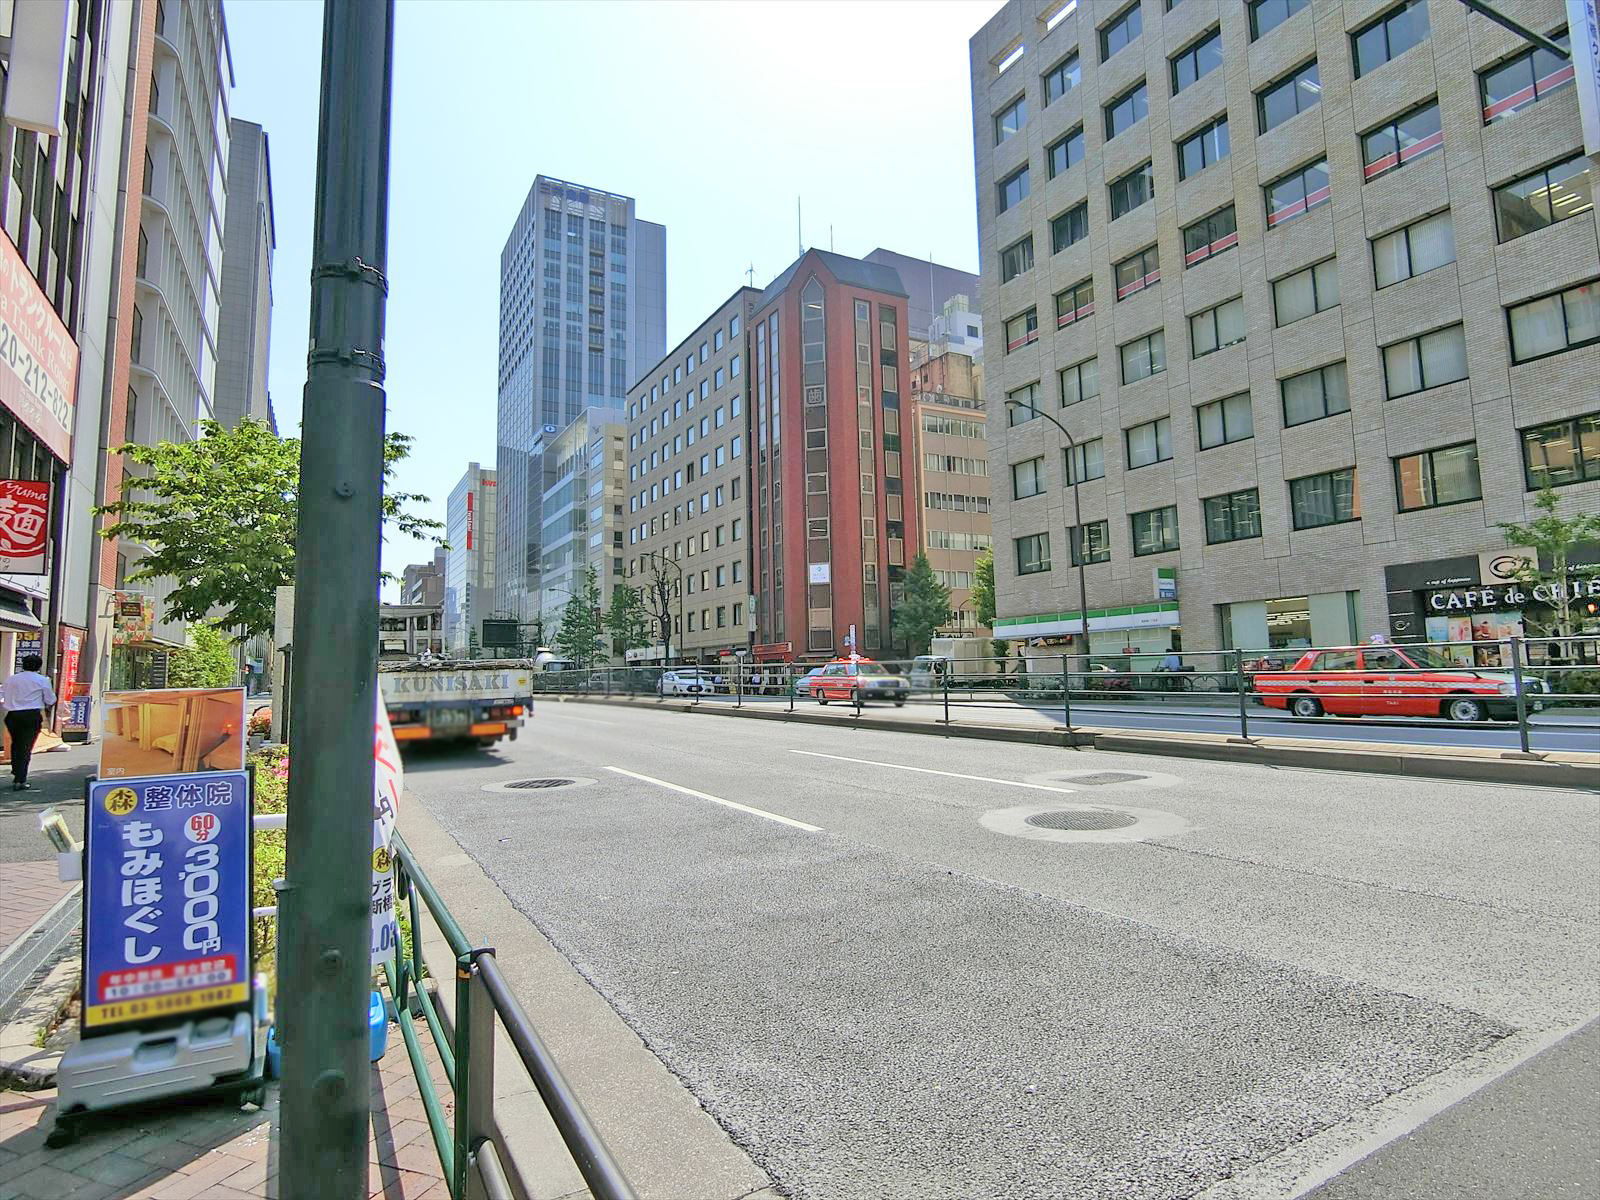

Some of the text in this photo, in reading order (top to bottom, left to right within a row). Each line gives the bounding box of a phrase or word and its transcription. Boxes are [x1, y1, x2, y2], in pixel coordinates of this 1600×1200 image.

[1430, 586, 1497, 610] CAFÉ
[1504, 588, 1525, 604] de
[393, 674, 509, 694] KUNISAKI
[109, 780, 233, 812] 森 整体院
[375, 848, 391, 869] 森
[120, 820, 164, 964] もみほぐし
[101, 1006, 124, 1020] TEL
